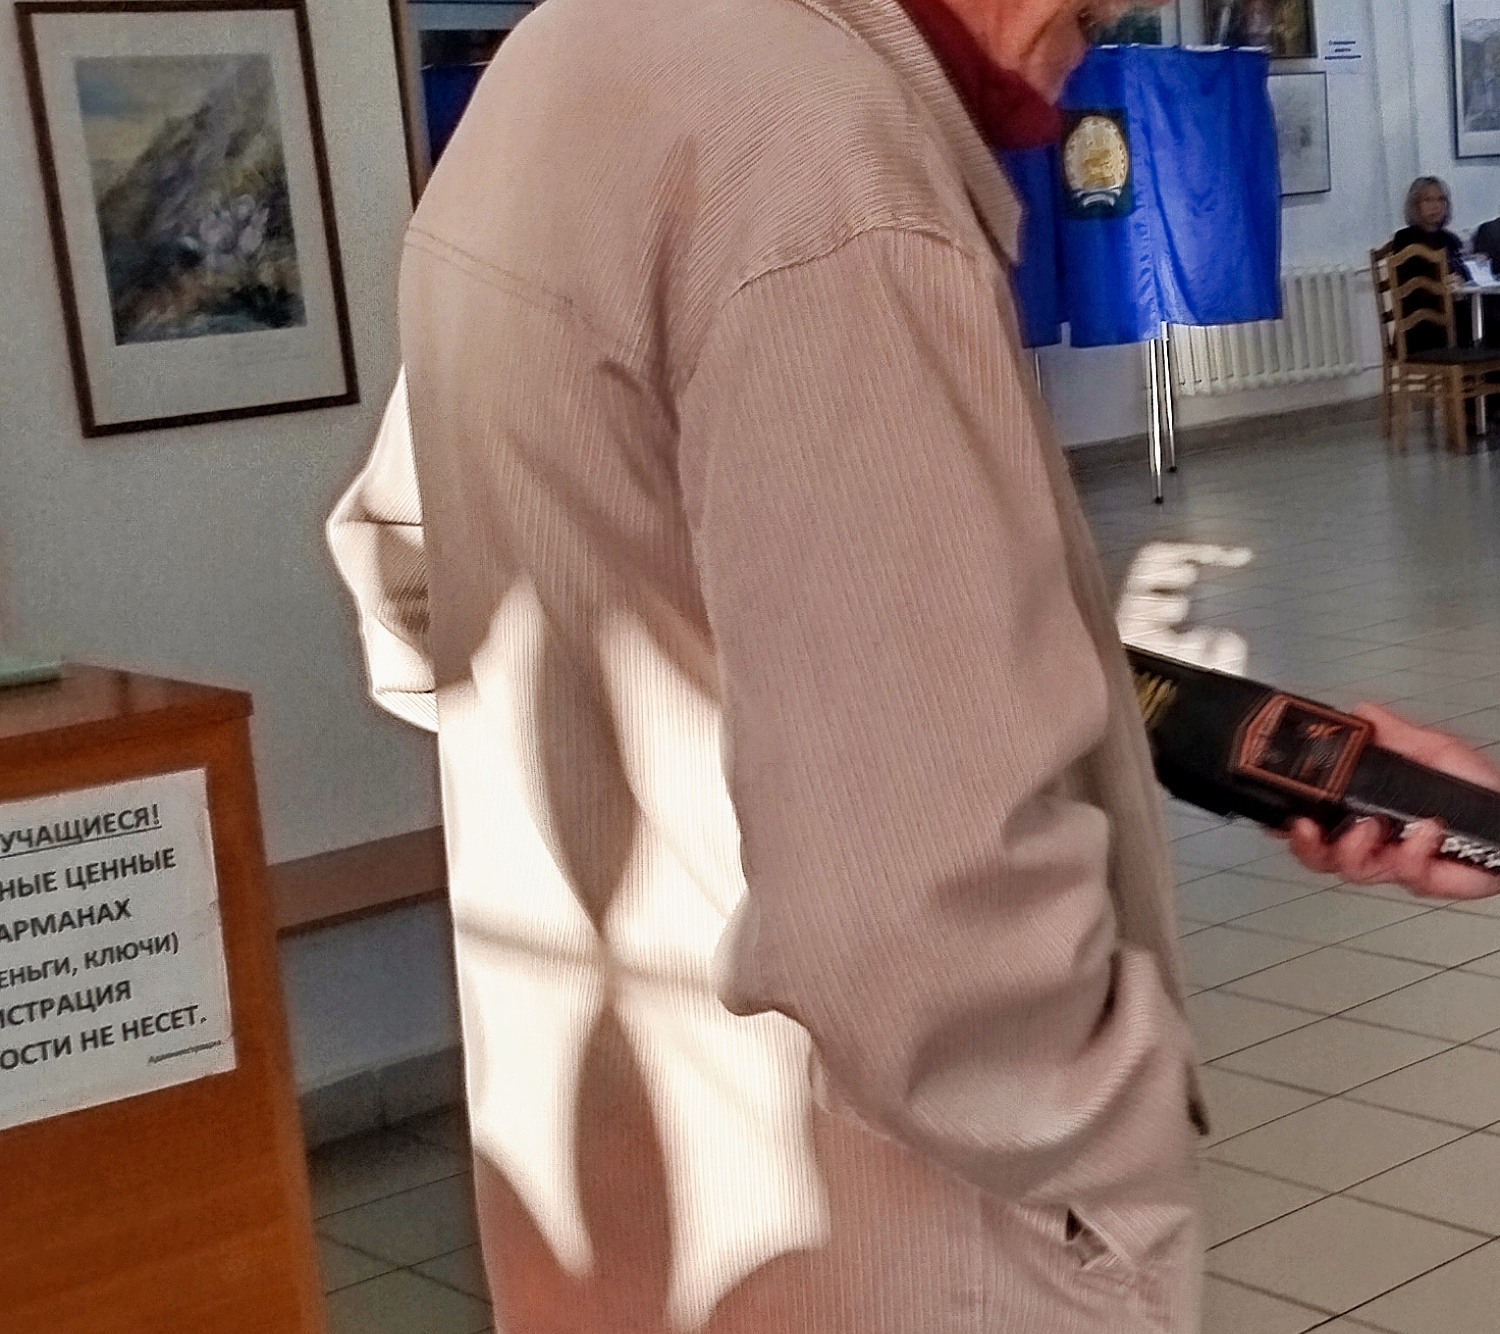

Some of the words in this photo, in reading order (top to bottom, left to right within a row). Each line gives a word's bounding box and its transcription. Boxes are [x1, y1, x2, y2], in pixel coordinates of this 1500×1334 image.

[0, 804, 159, 853] УЧАЩИЕСЯ!
[65, 848, 176, 890] ЦЕННЫЕ
[84, 933, 178, 969] КЛЮЧИ)
[0, 980, 131, 1029] СТРАЦИЯ
[0, 1035, 72, 1070] ОСТИ
[80, 1025, 115, 1052] НЕ
[122, 1005, 207, 1041] НЕСЕТ.
